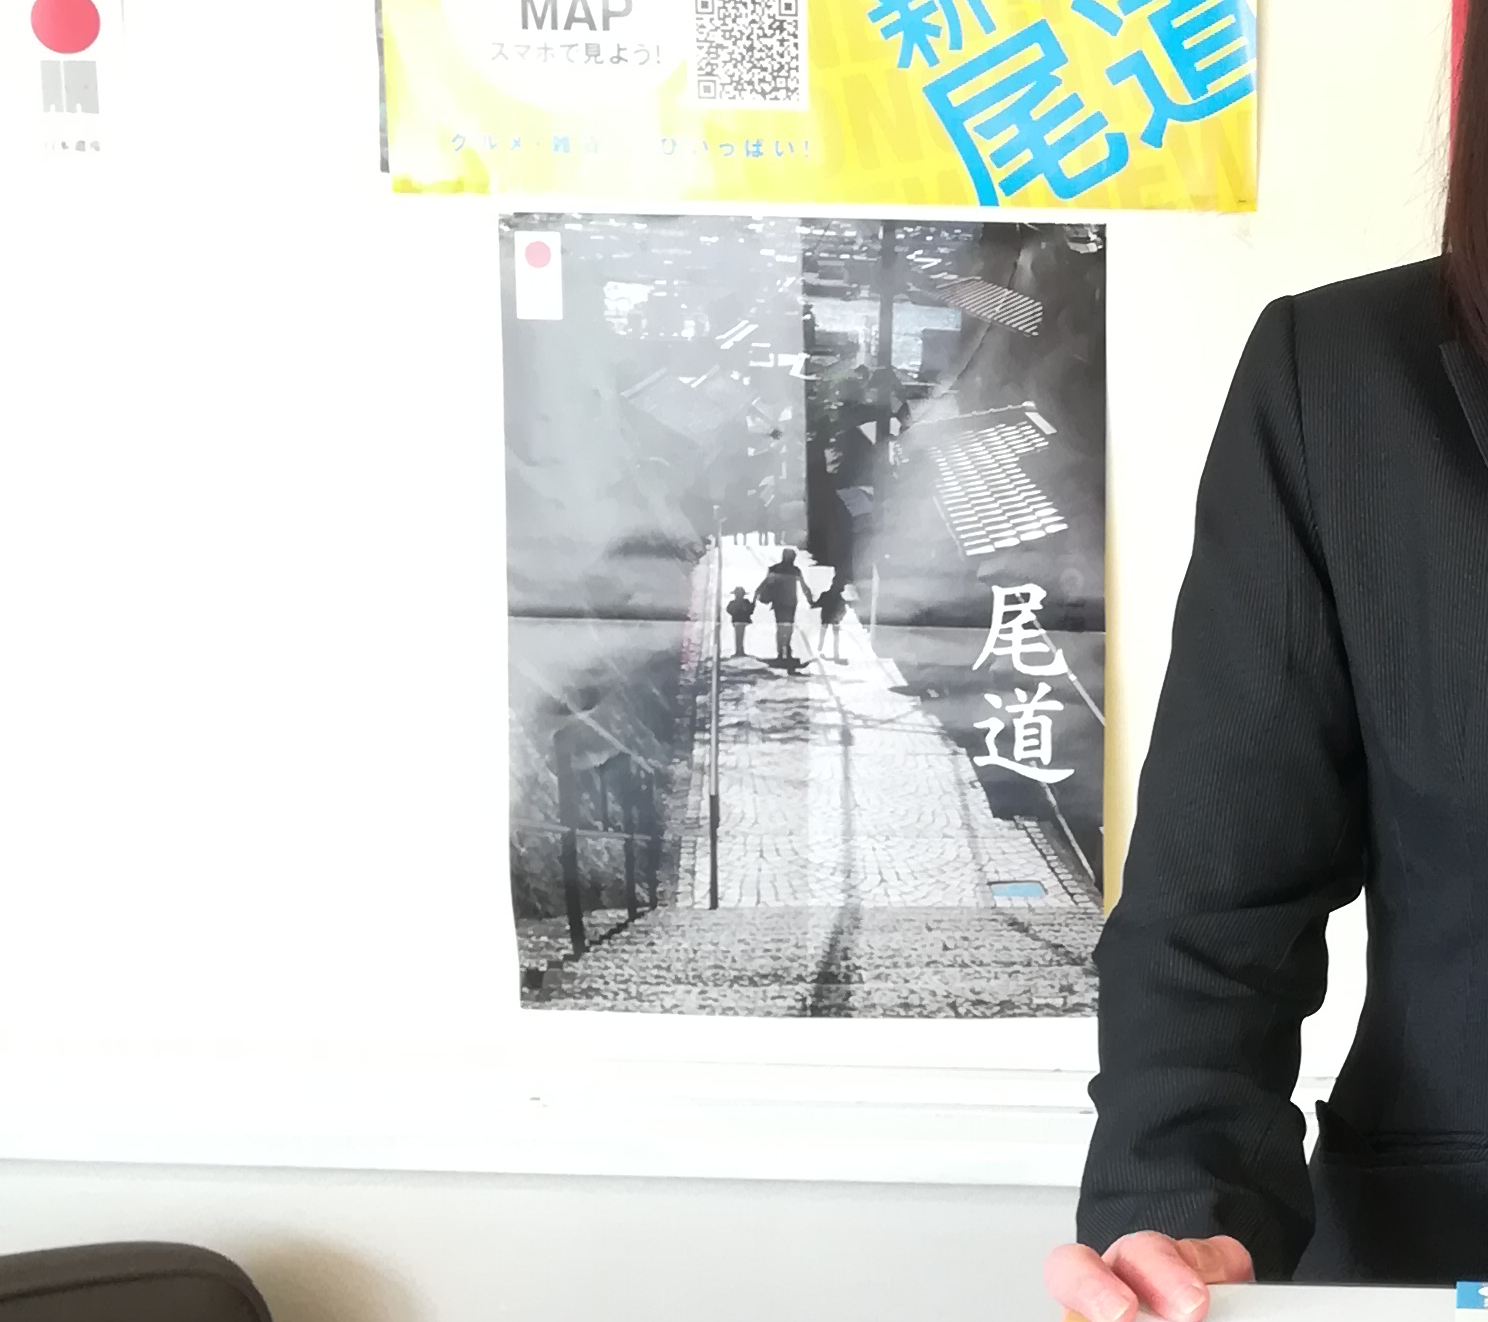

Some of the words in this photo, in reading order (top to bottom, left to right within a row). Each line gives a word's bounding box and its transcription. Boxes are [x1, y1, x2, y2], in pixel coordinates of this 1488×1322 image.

[490, 42, 662, 66] スマホで見よう!
[972, 582, 1076, 784] 尾道
